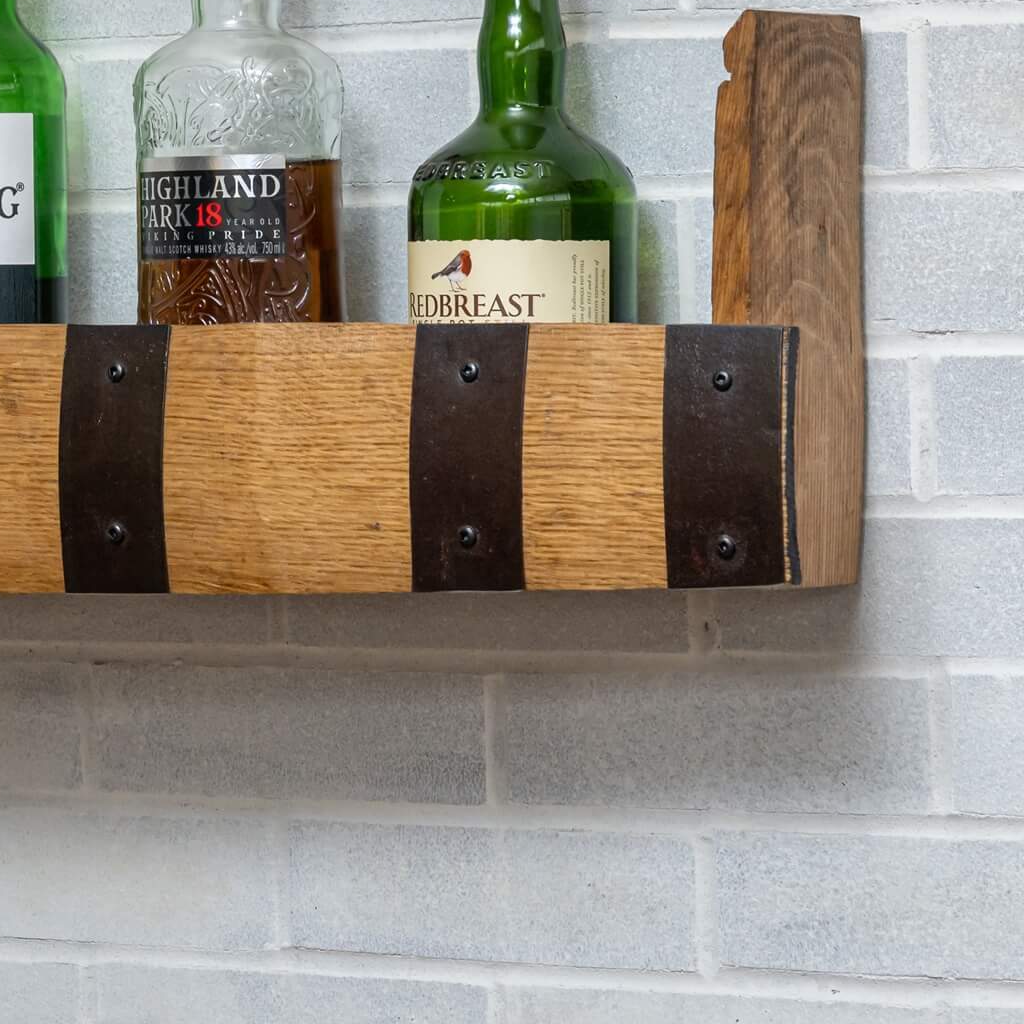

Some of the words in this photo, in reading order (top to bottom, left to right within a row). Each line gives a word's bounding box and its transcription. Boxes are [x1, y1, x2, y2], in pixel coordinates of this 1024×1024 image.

[141, 174, 281, 201] HIGHLAND
[142, 204, 193, 232] PARK
[195, 202, 223, 228] 18
[259, 217, 281, 225] OLD
[208, 229, 281, 241] PRIDE
[168, 244, 192, 254] SCOTCH
[194, 244, 222, 254] WHISKY
[261, 241, 273, 254] 750
[409, 292, 542, 317] REDBREAST
